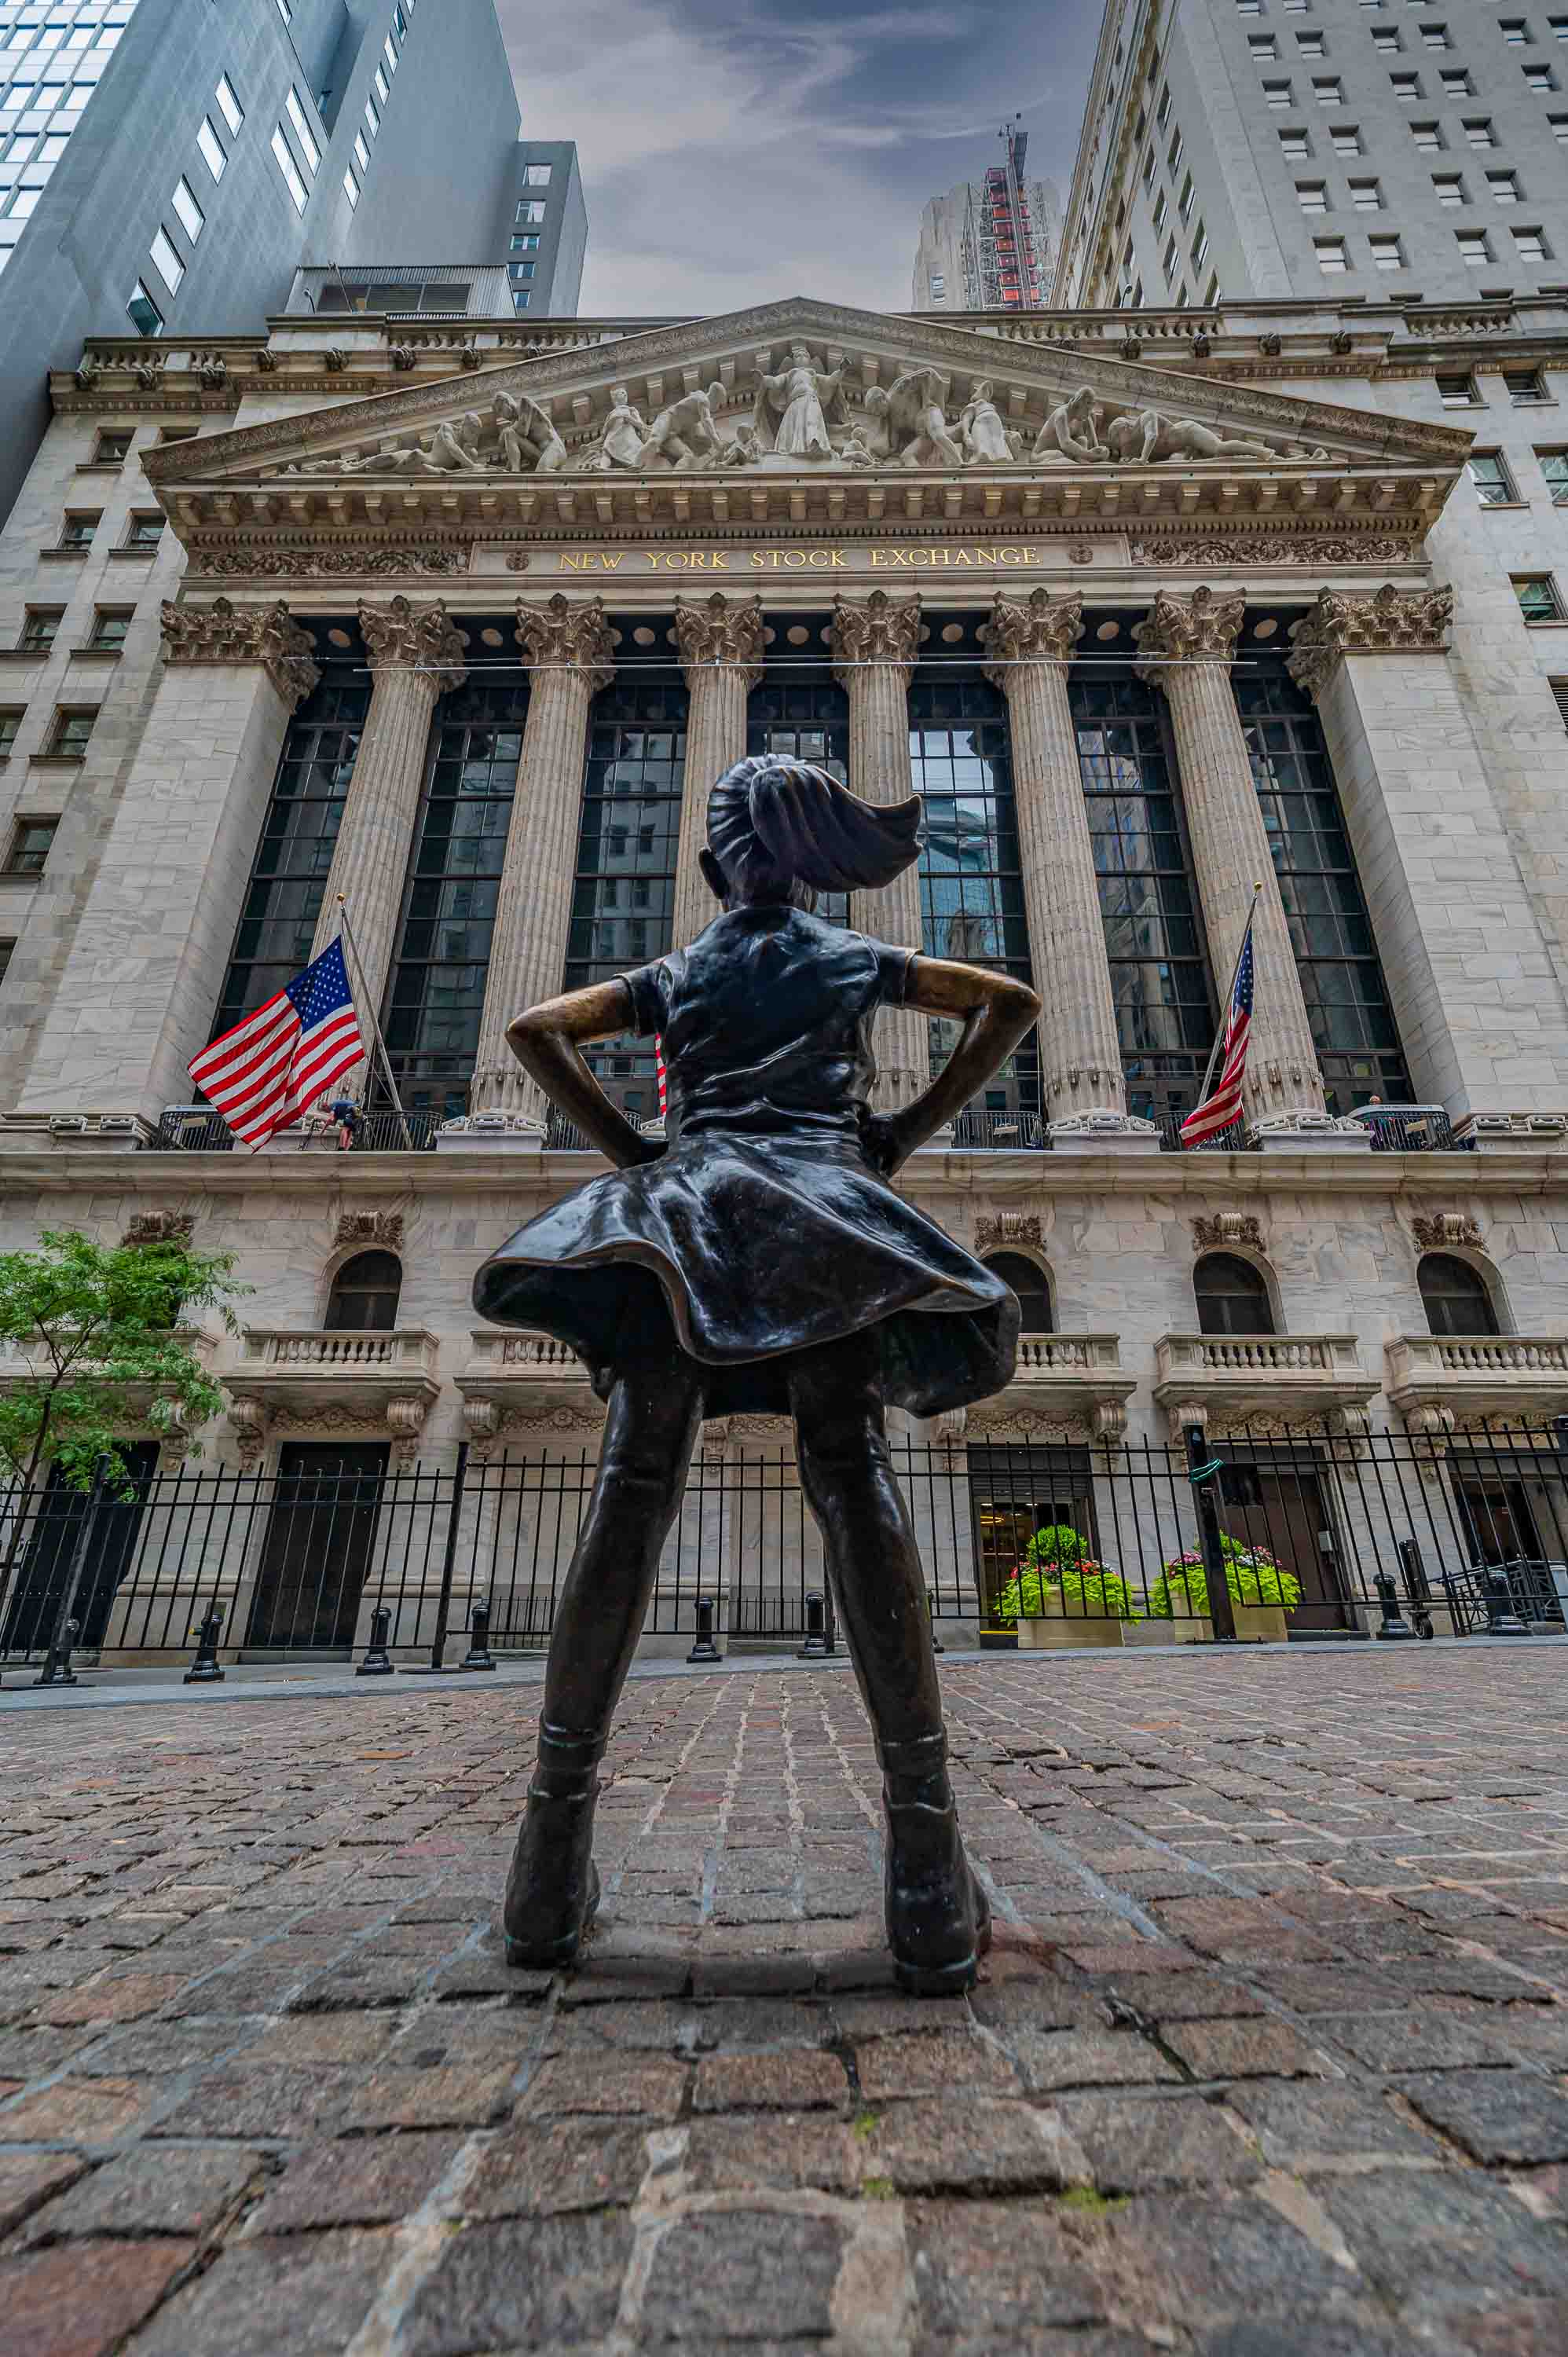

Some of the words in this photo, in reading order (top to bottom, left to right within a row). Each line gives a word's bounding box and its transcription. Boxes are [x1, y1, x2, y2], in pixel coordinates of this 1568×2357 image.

[559, 552, 625, 570] NEW
[647, 552, 729, 569] YORK
[750, 550, 849, 568] STOCK
[870, 548, 1040, 567] EXCHANGE
